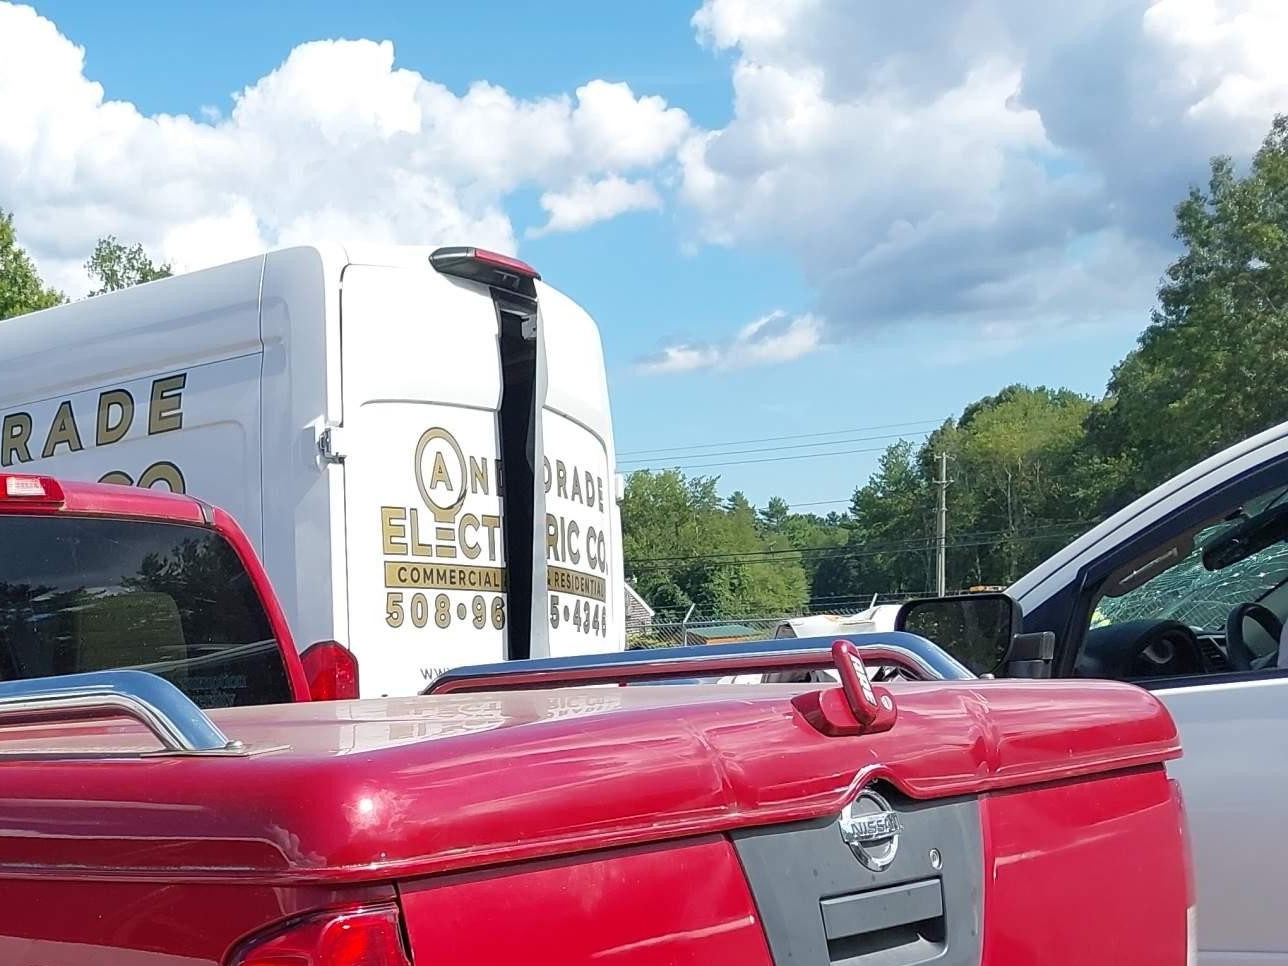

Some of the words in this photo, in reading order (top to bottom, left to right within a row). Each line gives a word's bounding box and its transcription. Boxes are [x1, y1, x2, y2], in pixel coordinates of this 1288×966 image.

[397, 566, 500, 588] COMMERCIAL
[554, 573, 605, 598] RESIDENTIAL
[850, 813, 900, 837] NISSAN
